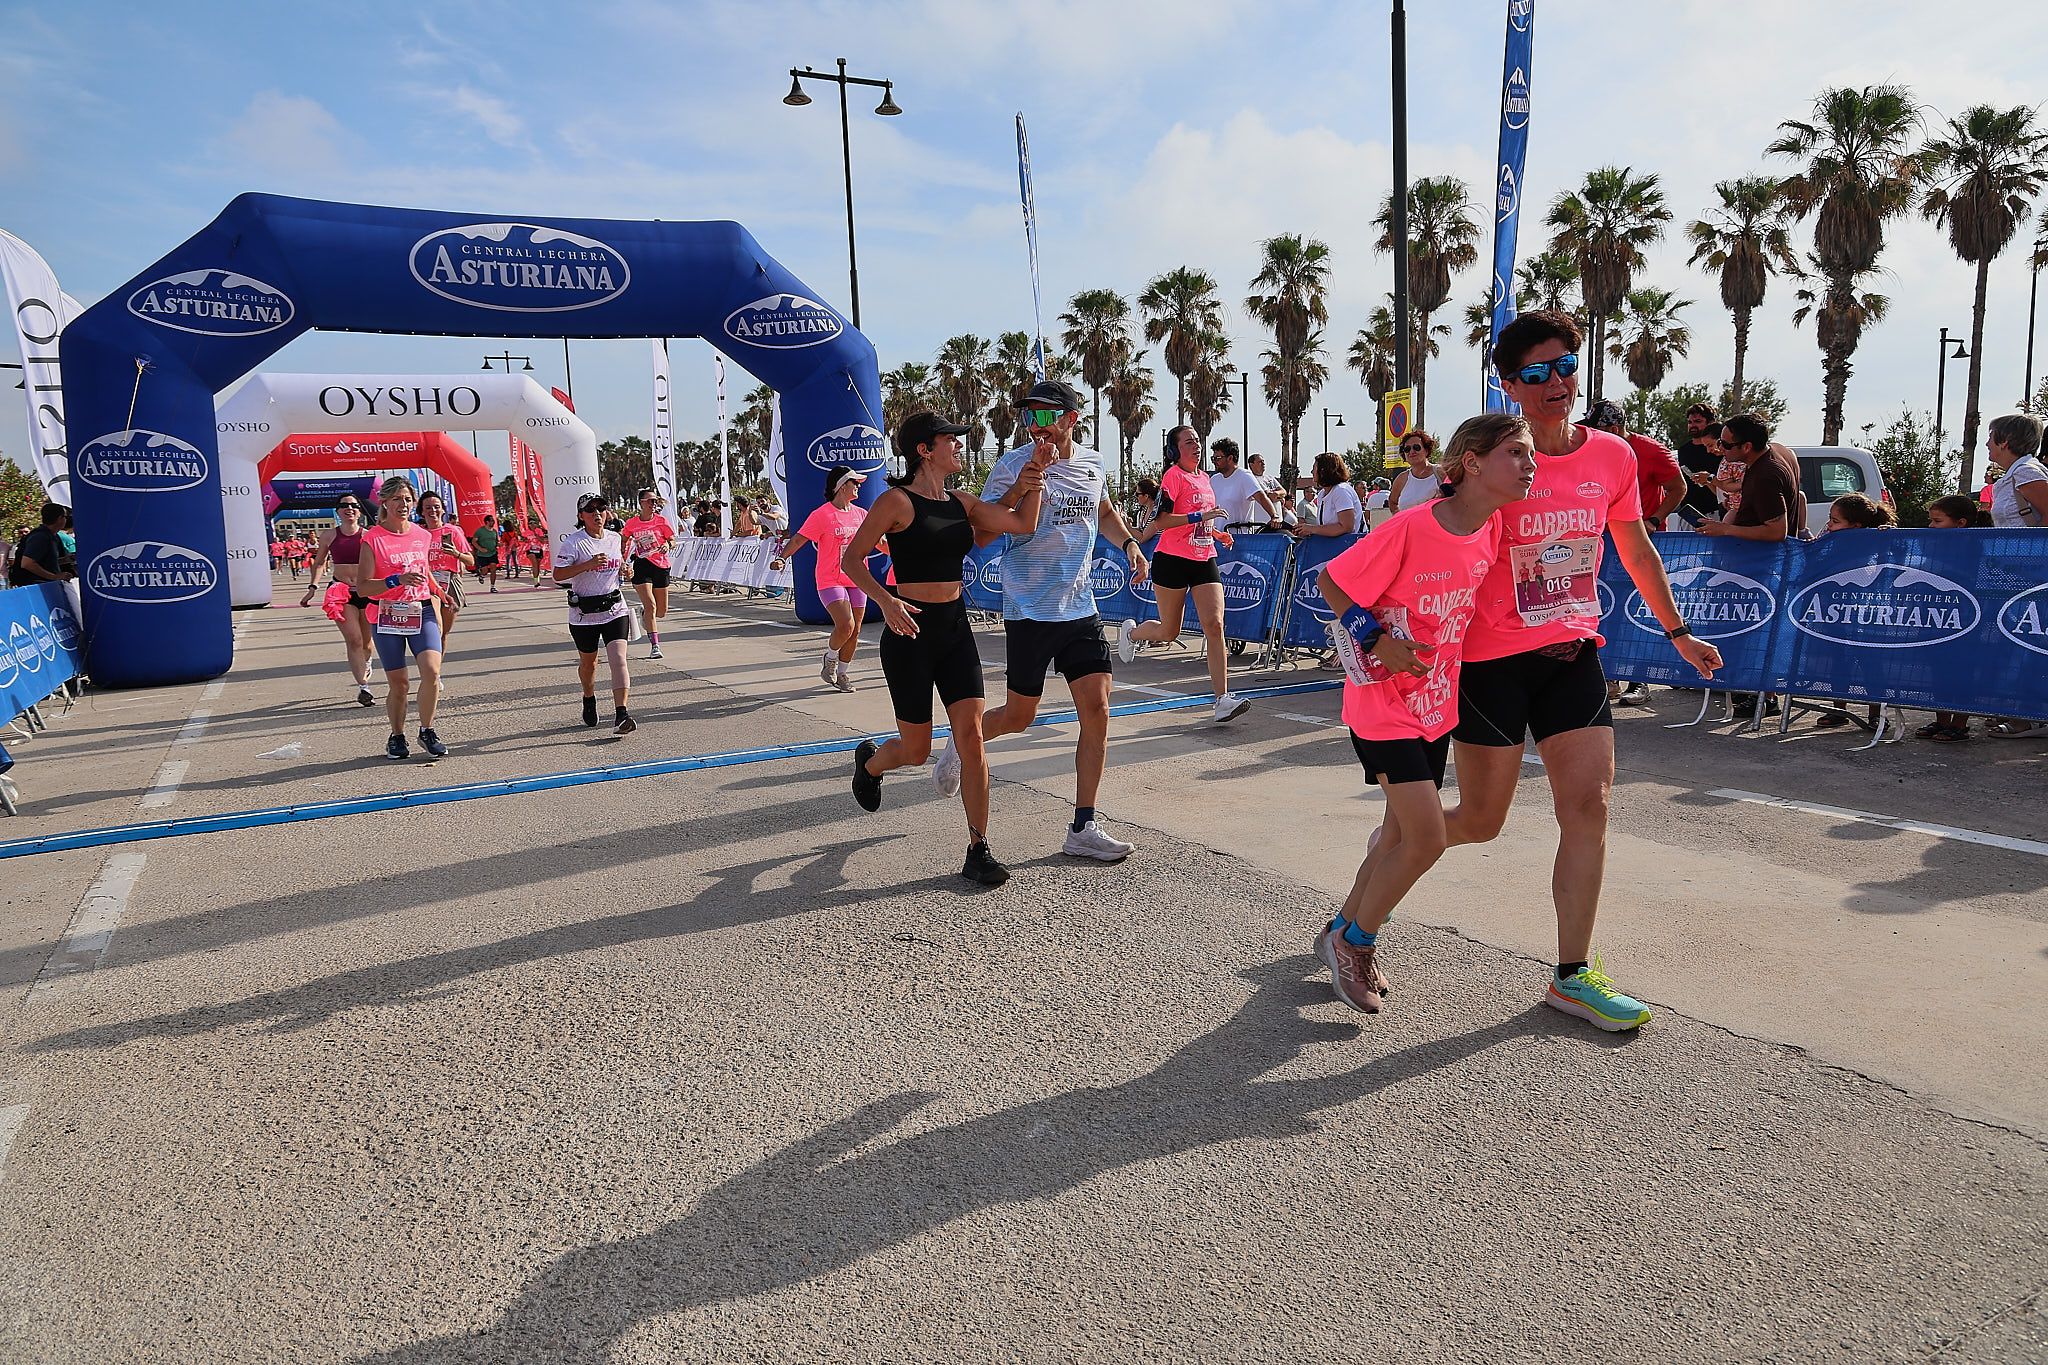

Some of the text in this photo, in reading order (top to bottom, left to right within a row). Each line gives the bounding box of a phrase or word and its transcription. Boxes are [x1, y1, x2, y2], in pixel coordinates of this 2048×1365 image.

[462, 244, 607, 261] CENTRAL LECHERA
[428, 244, 616, 290] ASTURIANA
[166, 288, 280, 304] CENTRAL LECHERA
[138, 290, 283, 323] ASTURIANA
[753, 312, 795, 320] CENTRAL
[735, 316, 839, 336] ASTURIANA
[319, 386, 481, 416] OYSHO
[217, 422, 270, 432] OYSHO
[526, 417, 570, 427] OYSHO
[100, 450, 197, 460] CENTRAL LECHERA
[289, 440, 418, 457] Sports Santander
[83, 452, 202, 478] ASTURIANA
[554, 475, 595, 486] OYSHO
[728, 544, 760, 563] OYSHO
[94, 564, 211, 588] ASTURIANA
[1414, 570, 1452, 583] OYSHO
[1546, 576, 1572, 593] 016
[1896, 593, 1961, 604] LECHERA
[392, 615, 408, 623] 016
[1800, 592, 1963, 629] ASTURIANA
[1338, 629, 1351, 658] OYSHO
